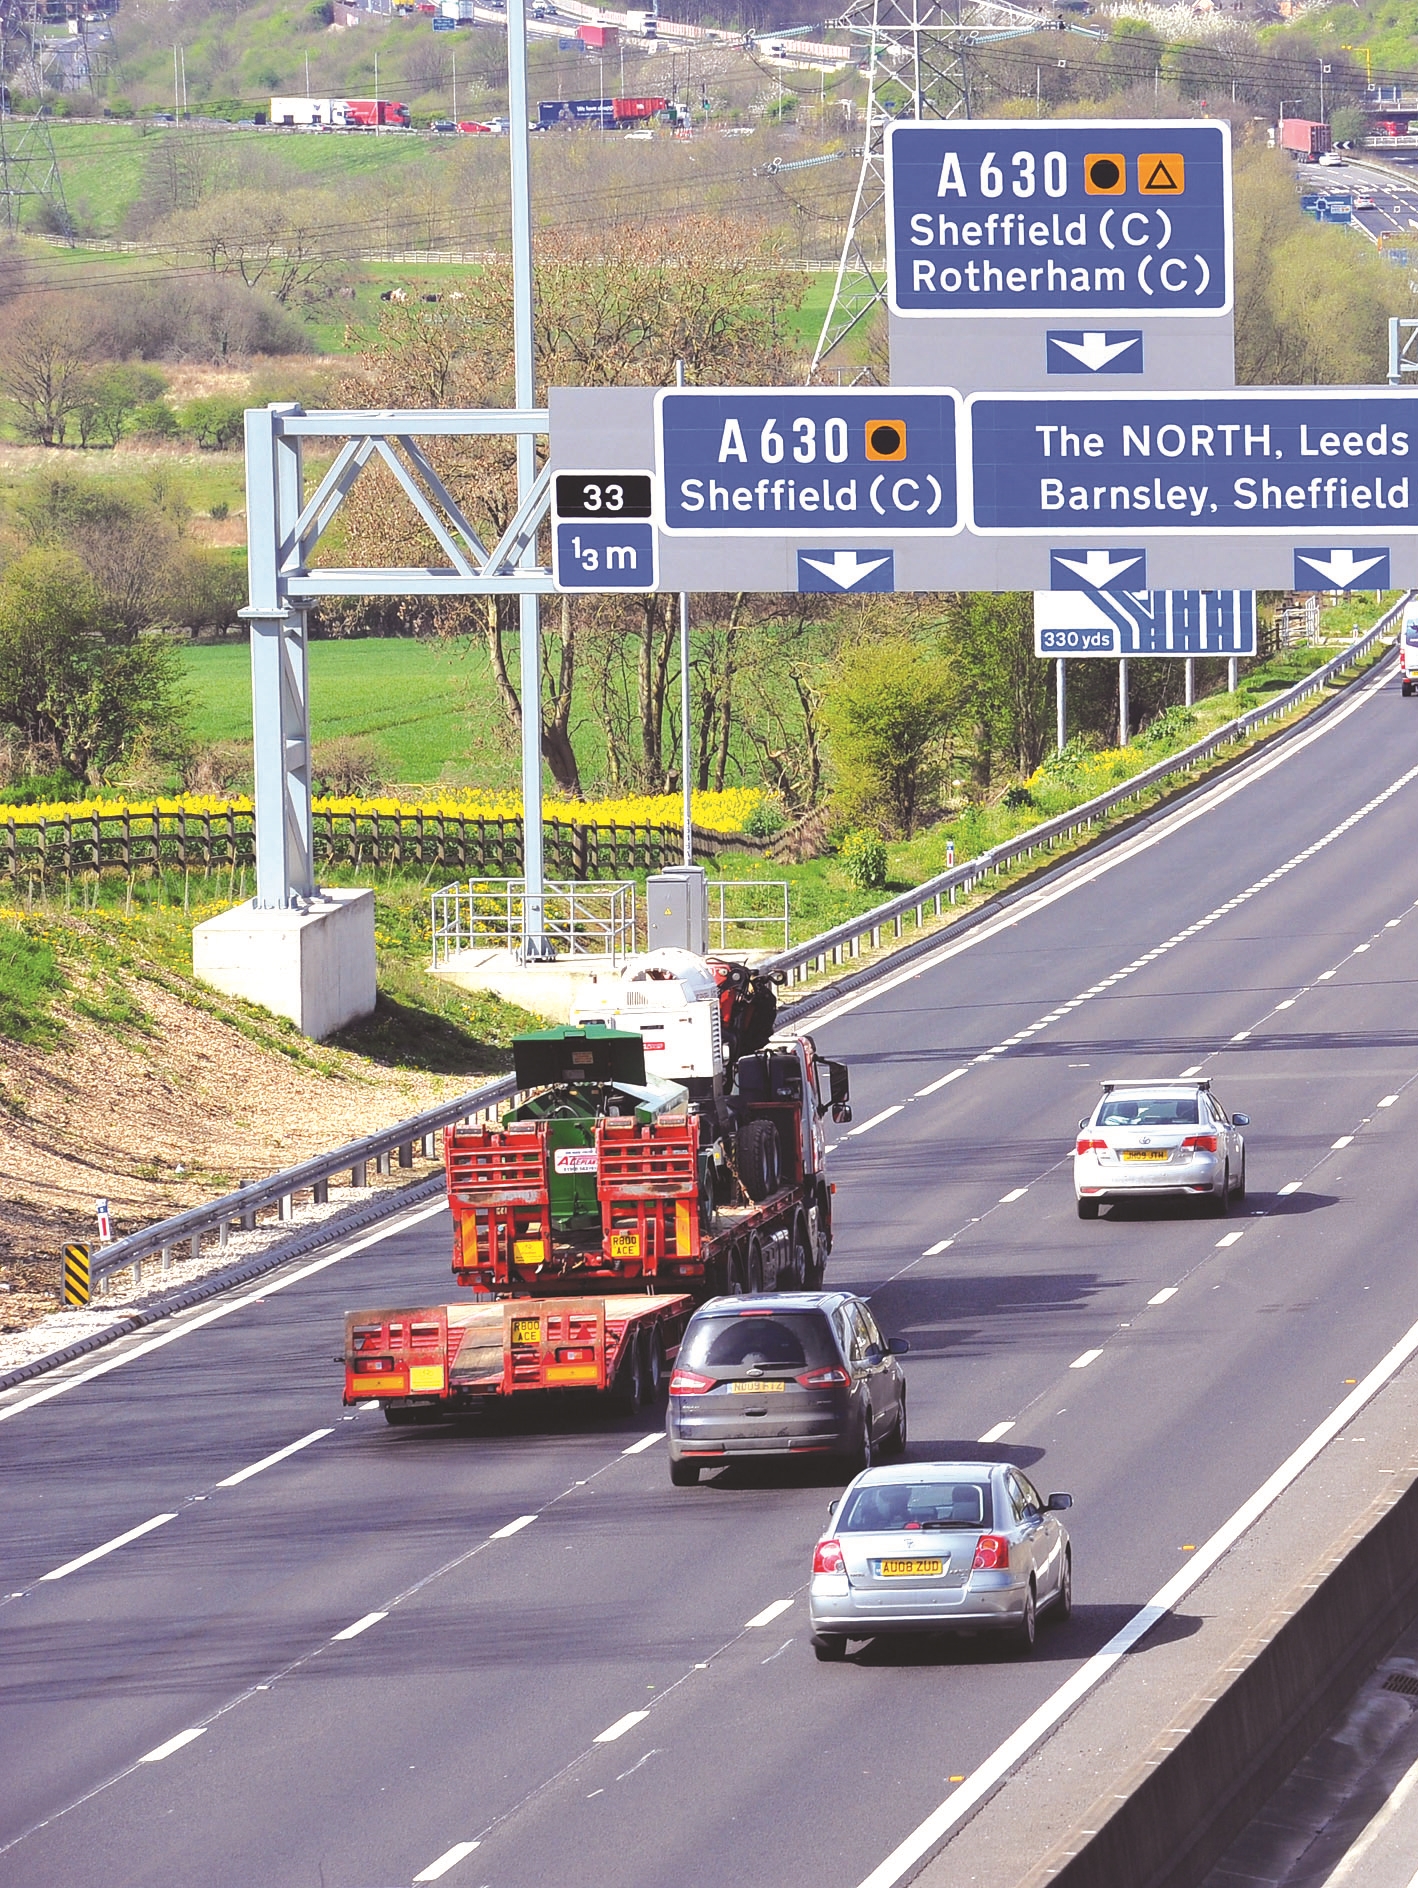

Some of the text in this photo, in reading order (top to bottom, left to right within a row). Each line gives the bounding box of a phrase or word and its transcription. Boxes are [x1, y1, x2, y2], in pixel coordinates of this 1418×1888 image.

[910, 208, 1172, 250] Sheffield (C)
[912, 254, 1210, 296] Rotherham (C)
[1035, 423, 1409, 460] The NORTH, Leeds
[583, 484, 624, 511] 33
[680, 474, 942, 515] Sheffield (C)
[1040, 477, 1218, 517] Barnsley,
[1233, 476, 1409, 510] Sheffield
[1044, 631, 1110, 650] 330 yds
[557, 1155, 598, 1166] ACEPLAN
[617, 1246, 634, 1255] ACE
[518, 1331, 537, 1341] ACE
[883, 1561, 913, 1574] AU08
